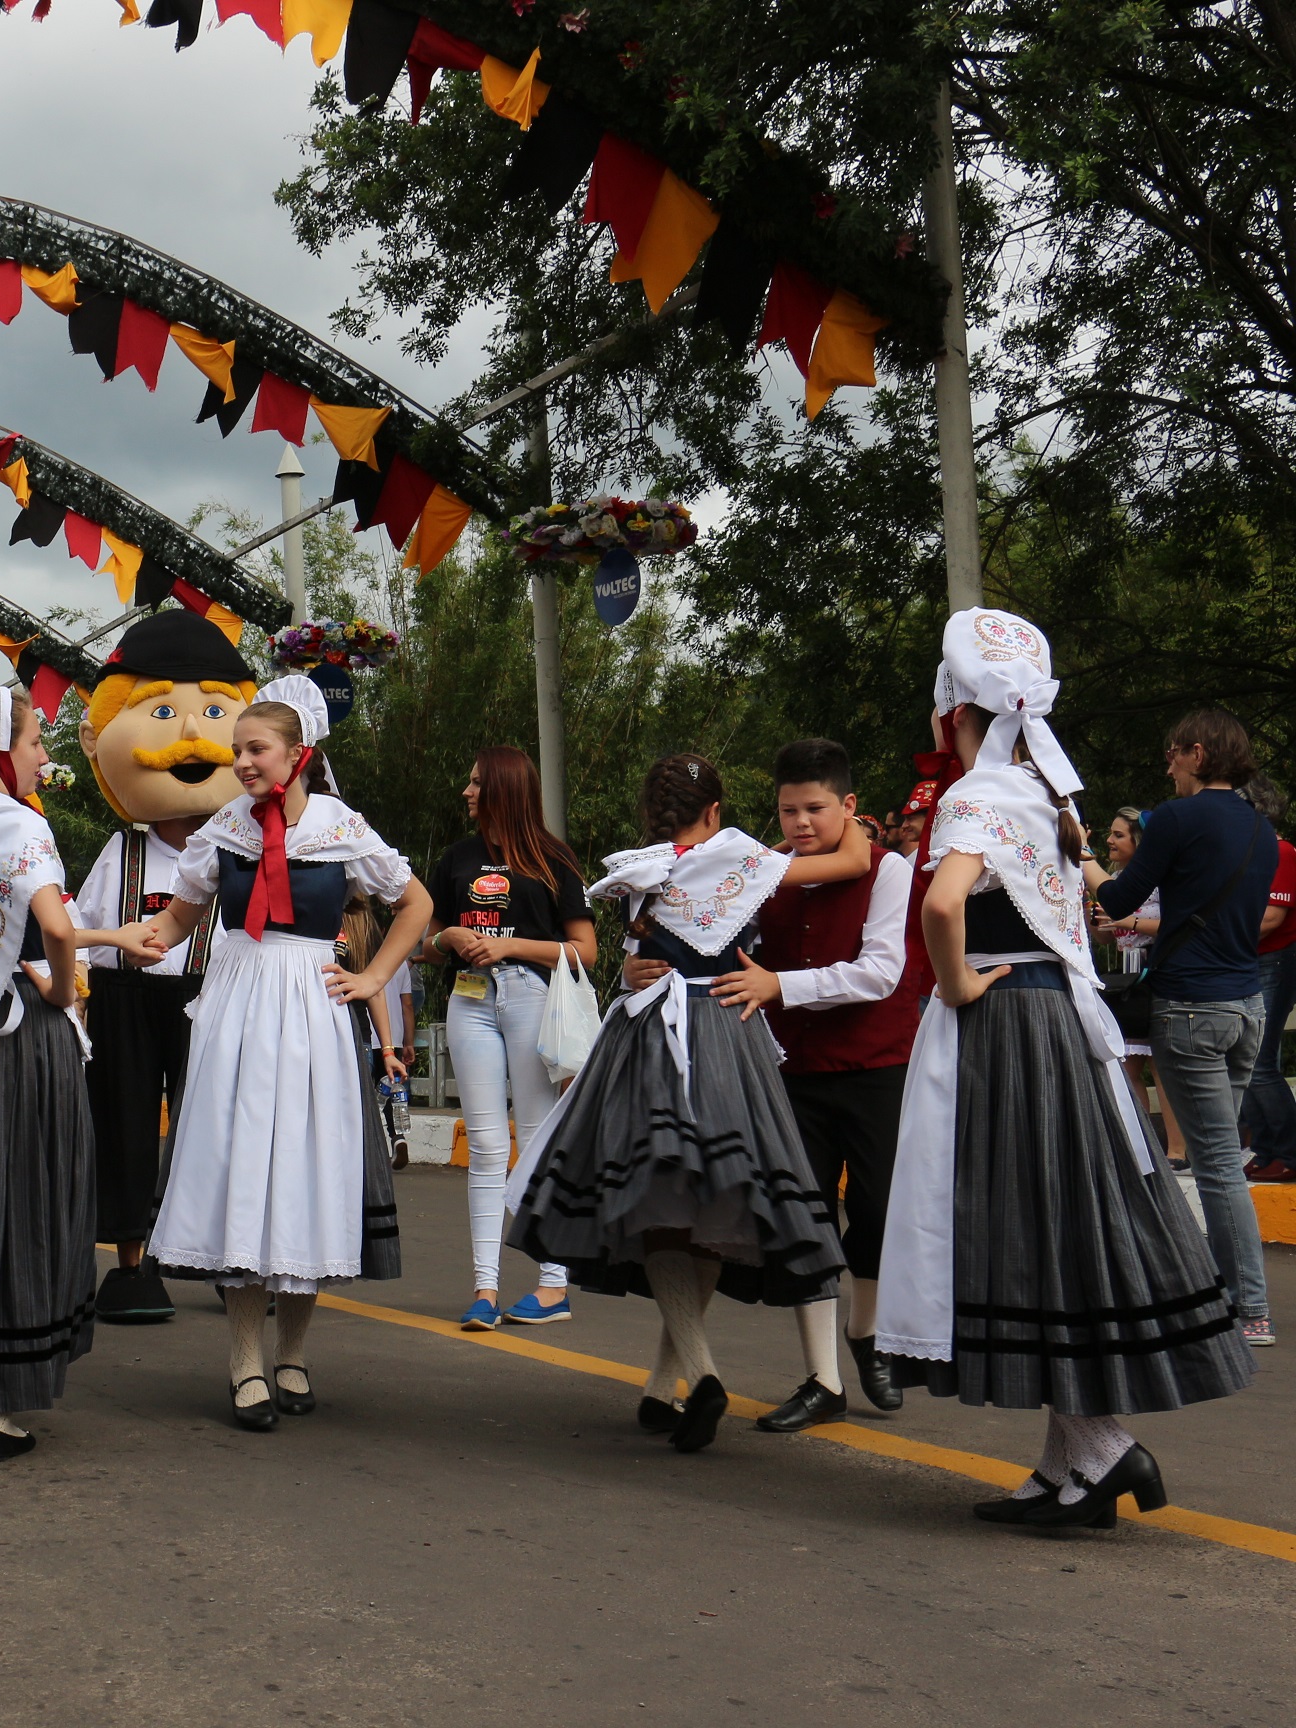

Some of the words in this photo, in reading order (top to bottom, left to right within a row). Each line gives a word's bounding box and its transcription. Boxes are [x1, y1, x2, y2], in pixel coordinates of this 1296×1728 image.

[595, 574, 637, 599] VOLTEC
[323, 687, 350, 700] LTEC
[146, 895, 171, 911] Ha
[461, 909, 499, 926] DIVERSÃO
